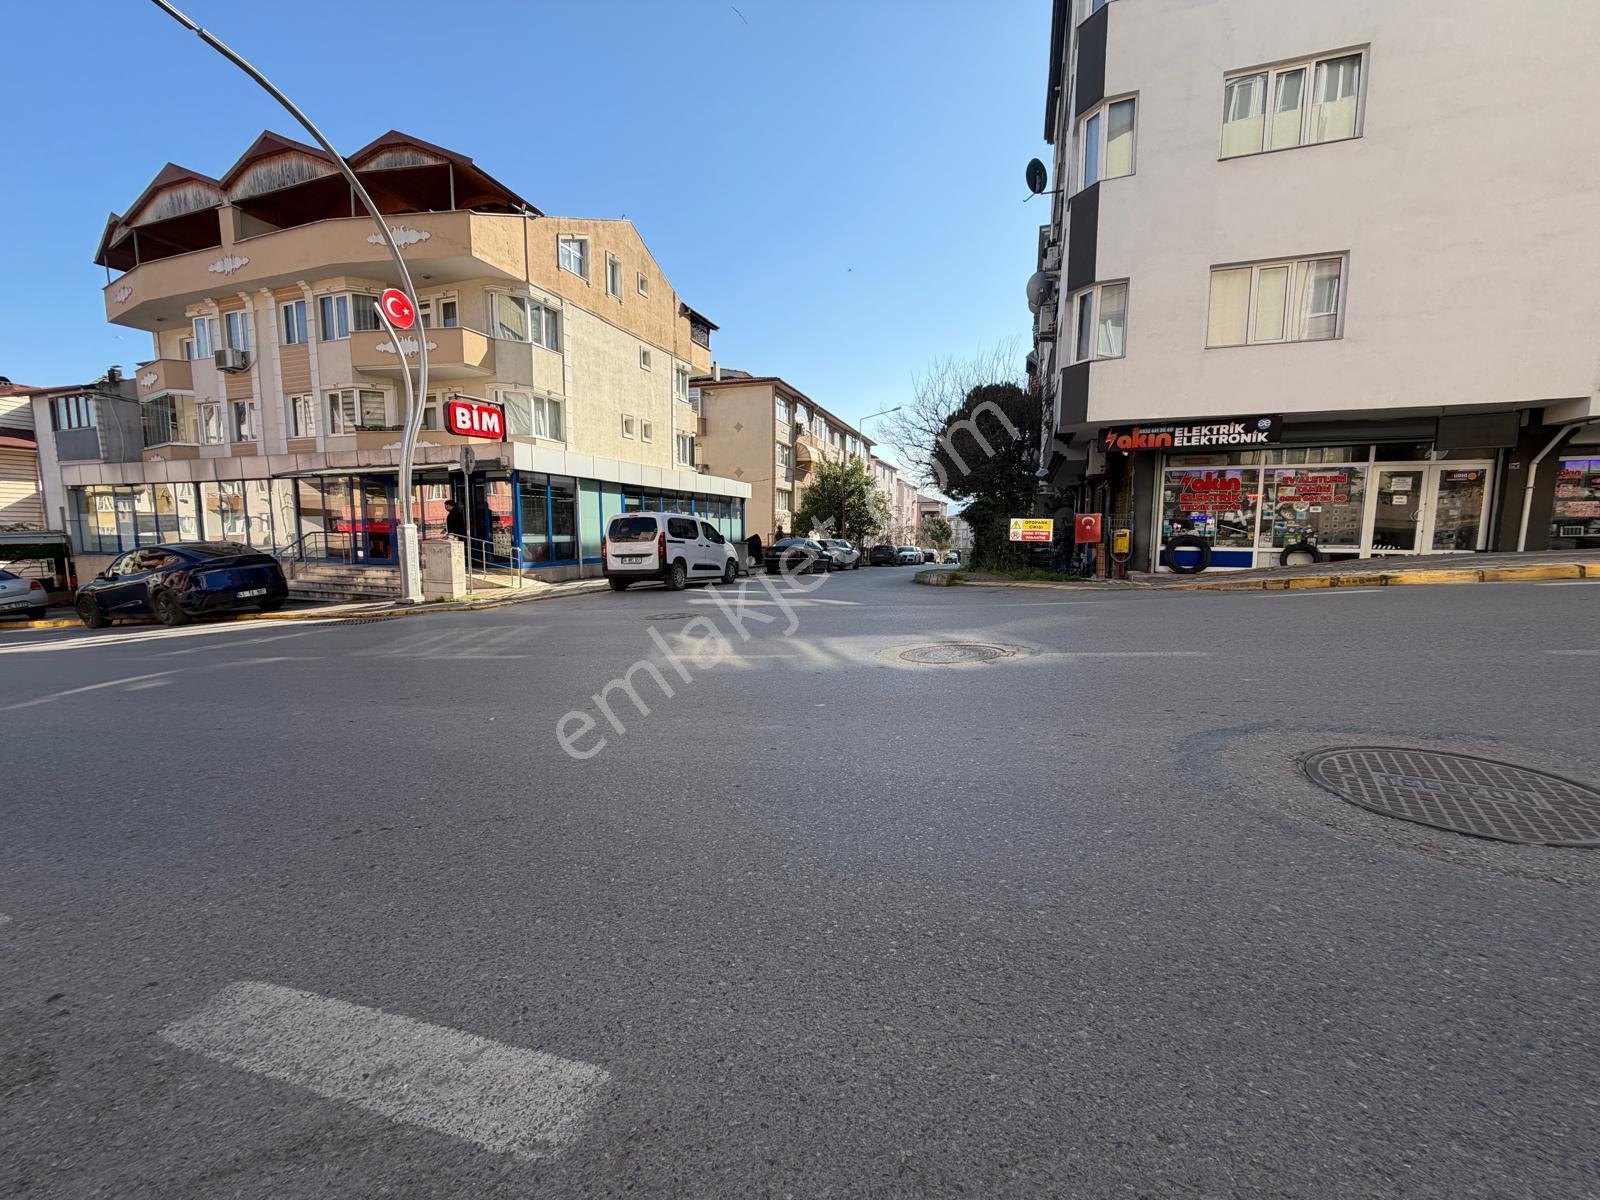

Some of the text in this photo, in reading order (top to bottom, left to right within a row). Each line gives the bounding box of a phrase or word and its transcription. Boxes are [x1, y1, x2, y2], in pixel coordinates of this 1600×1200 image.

[455, 404, 501, 433] BİM
[1174, 422, 1247, 437] ELEKTRİK
[1174, 431, 1269, 447] ELEKTRONİK
